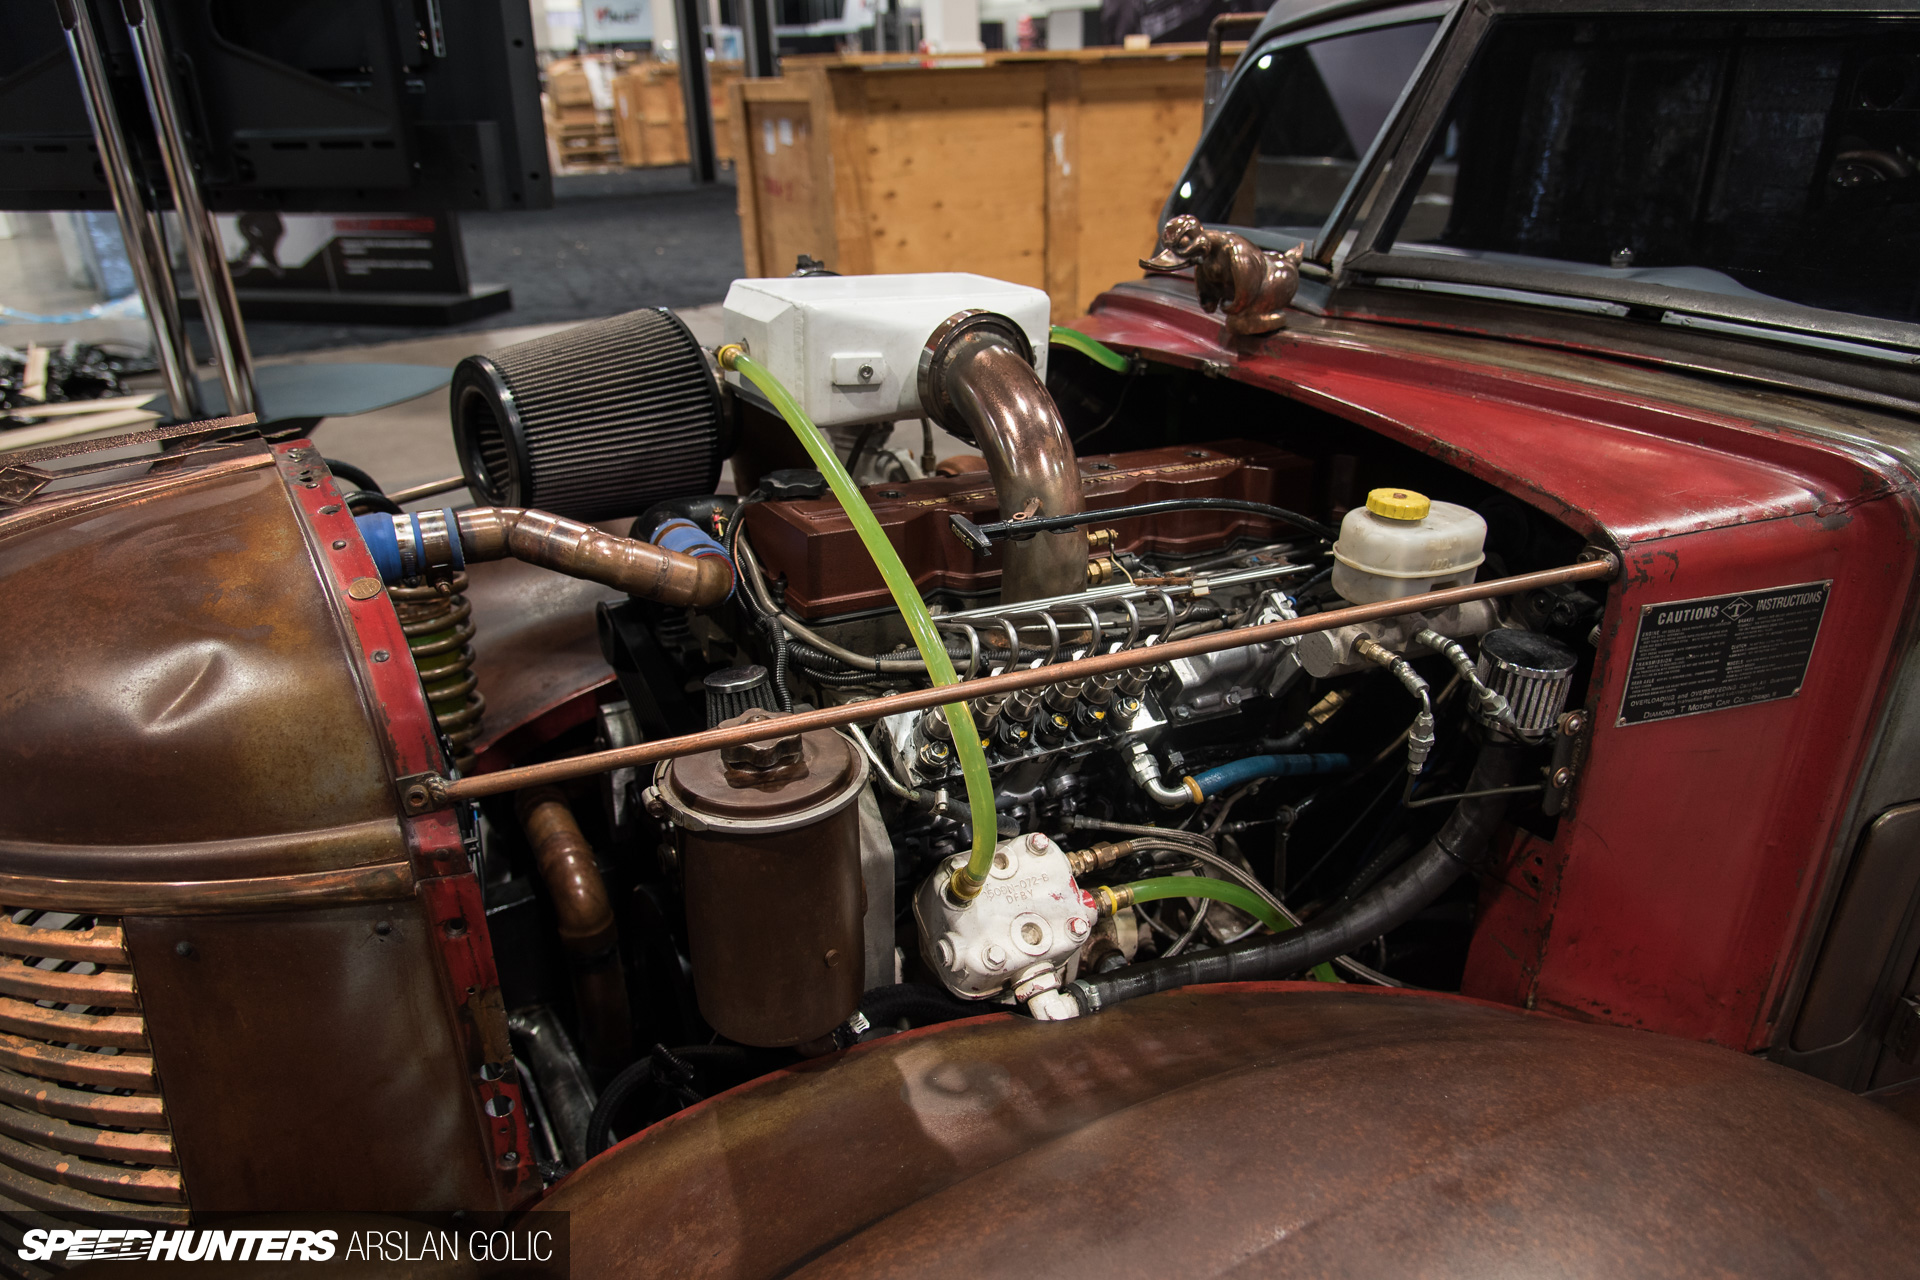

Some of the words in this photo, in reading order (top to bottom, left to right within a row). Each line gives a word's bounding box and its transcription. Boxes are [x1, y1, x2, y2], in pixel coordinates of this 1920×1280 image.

[1657, 605, 1720, 626] CAUTIONS
[1755, 590, 1822, 612] INSTRUCTIONS
[1630, 694, 1675, 707] OVERLOADING
[1690, 684, 1736, 698] OVERSPEEDING
[1738, 681, 1758, 689] Cancel
[1643, 708, 1675, 719] DIAMOND
[1680, 705, 1686, 713] T
[1688, 702, 1713, 711] MOTOR
[1716, 699, 1731, 707] CAR
